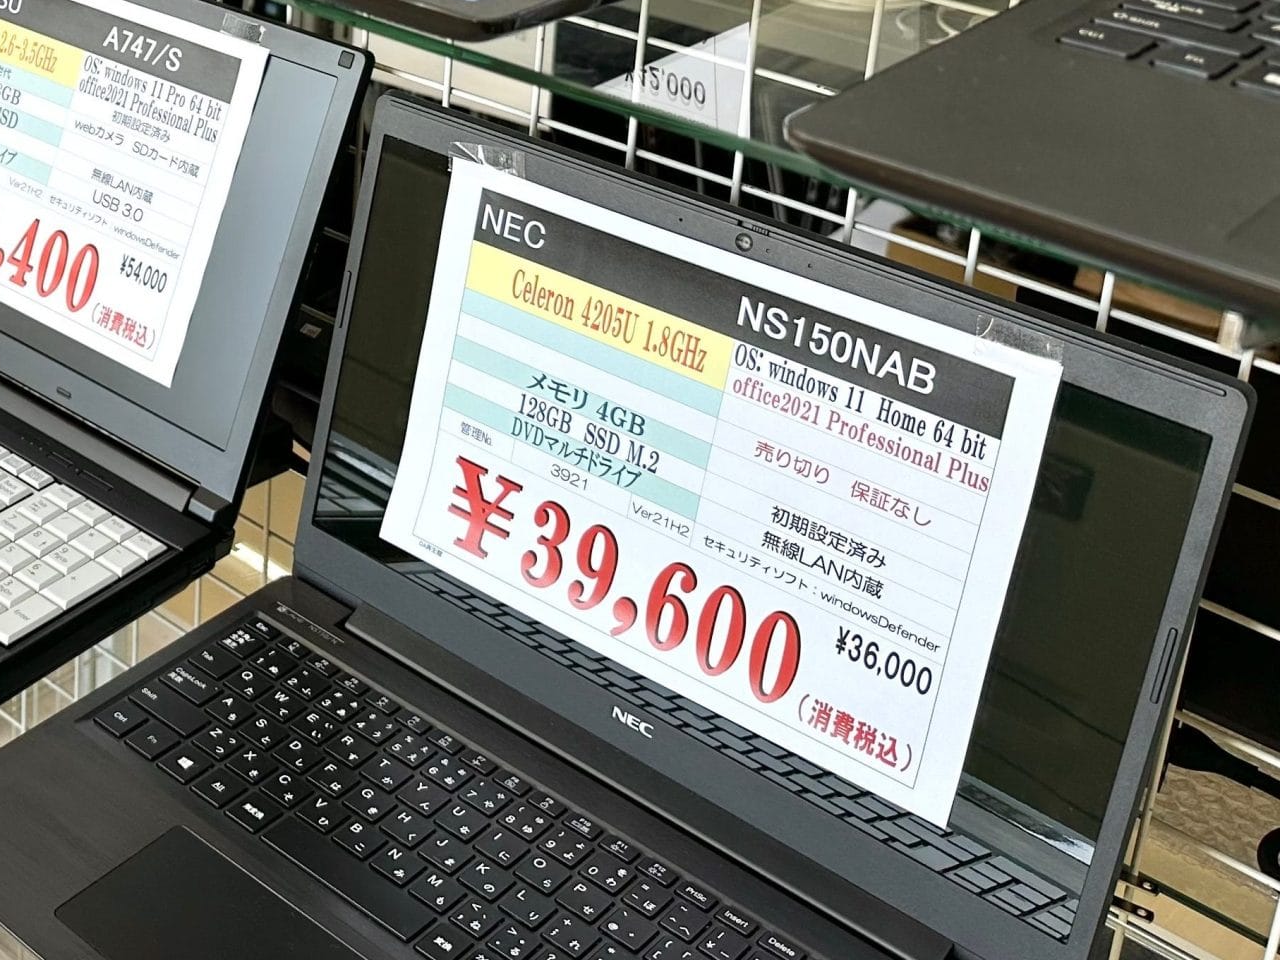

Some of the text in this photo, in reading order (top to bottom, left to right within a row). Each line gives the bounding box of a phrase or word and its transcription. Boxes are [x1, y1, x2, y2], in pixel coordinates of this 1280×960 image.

[103, 26, 182, 72] A747/S
[79, 76, 218, 143] office2021 Professional Plus
[105, 65, 148, 93] windows
[151, 81, 164, 100] 11
[166, 86, 185, 107] Pro
[190, 95, 203, 114] 64
[206, 100, 221, 121] bit
[74, 119, 200, 179] webカメラ SDカード内蔵
[112, 111, 170, 143] 初期設定済み
[91, 167, 153, 204] 無線LAN内蔵
[92, 189, 144, 222] USB 3.0
[114, 226, 180, 259] windowsDefender
[120, 253, 167, 293] ¥54,000
[481, 203, 937, 396] NEC NS150NAB
[511, 268, 708, 373] Celeron 4205U 1.8GHz
[517, 393, 660, 474] 128GB SSD M.2
[526, 372, 647, 437] メモリ 4GB
[731, 375, 989, 493] office2021 Professional Plus
[734, 342, 987, 461] OS: windows 11 Home 64 bit
[511, 417, 642, 488] DVDマルチドライブ
[551, 463, 589, 490] 3921
[754, 440, 933, 527] 売り切り 保証なし
[632, 501, 690, 538] Ver21H2
[769, 504, 888, 569] 初期設定済み
[447, 456, 802, 704] ¥39,600
[760, 529, 885, 600] 無線LAN内蔵
[835, 627, 934, 697] ¥36,000
[612, 706, 654, 739] NEC
[795, 692, 913, 772] （消費税込）
[724, 910, 749, 928] Insert
[768, 937, 795, 957] Delete
